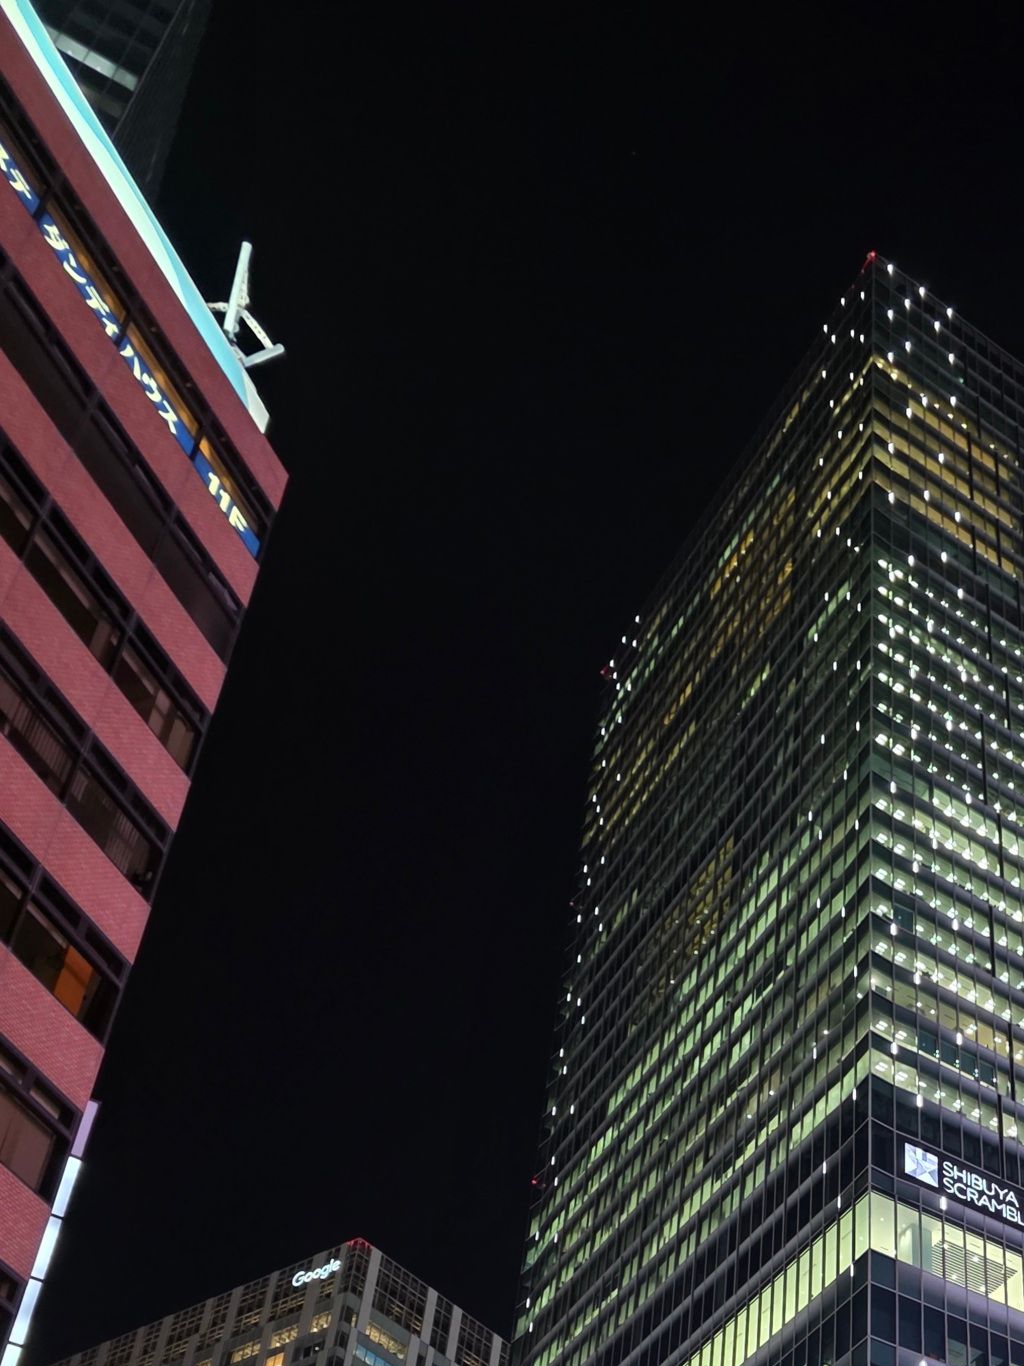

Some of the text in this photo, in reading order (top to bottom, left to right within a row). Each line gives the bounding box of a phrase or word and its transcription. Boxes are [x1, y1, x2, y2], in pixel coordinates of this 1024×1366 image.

[43, 223, 178, 434] ダンディハウス
[208, 471, 248, 532] 11F
[942, 1161, 1019, 1208] SHIBUYA
[291, 1258, 341, 1287] Google
